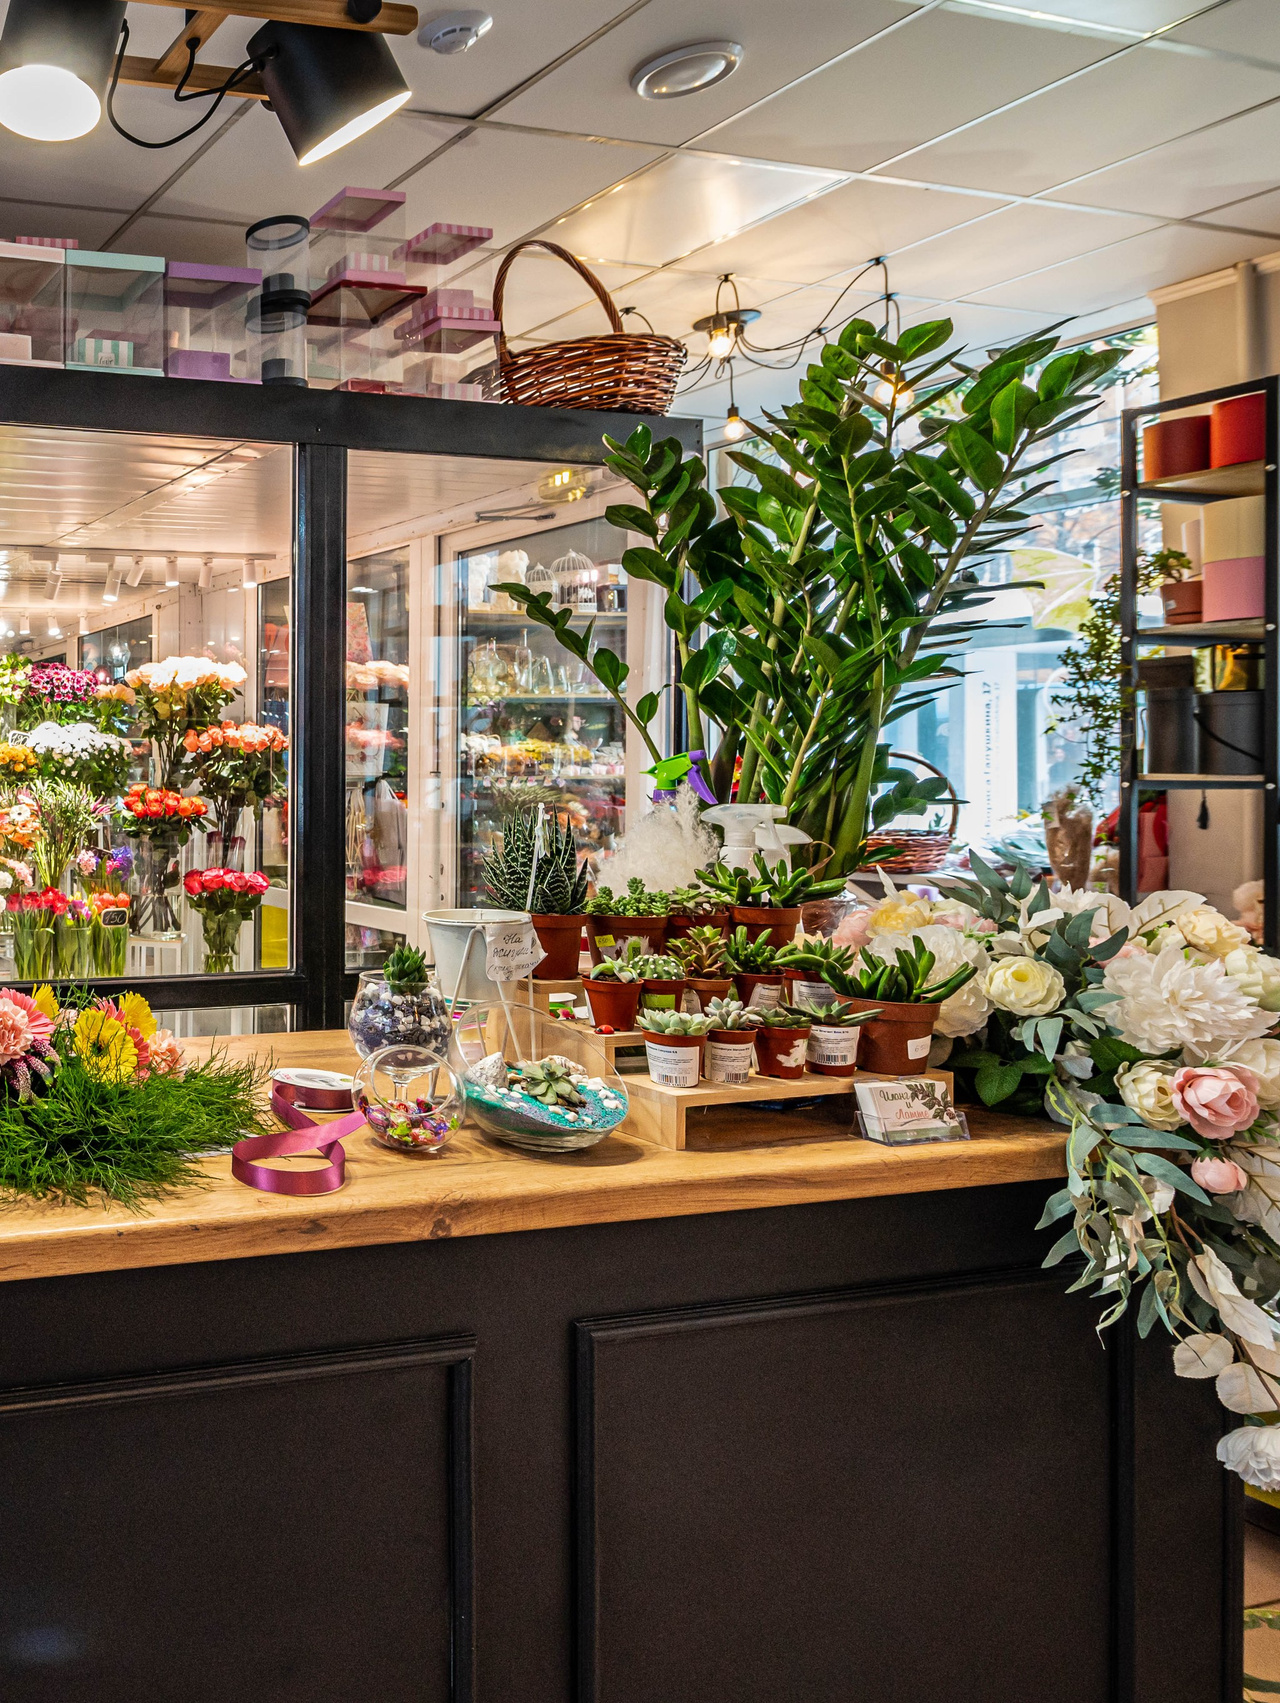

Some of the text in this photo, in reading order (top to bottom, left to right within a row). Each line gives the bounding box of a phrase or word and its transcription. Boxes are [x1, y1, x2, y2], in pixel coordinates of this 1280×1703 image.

[982, 682, 991, 695] 17
[105, 911, 125, 924] 150
[879, 1089, 910, 1102] Иланг
[905, 1101, 913, 1109] и
[895, 1109, 929, 1120] Латте
